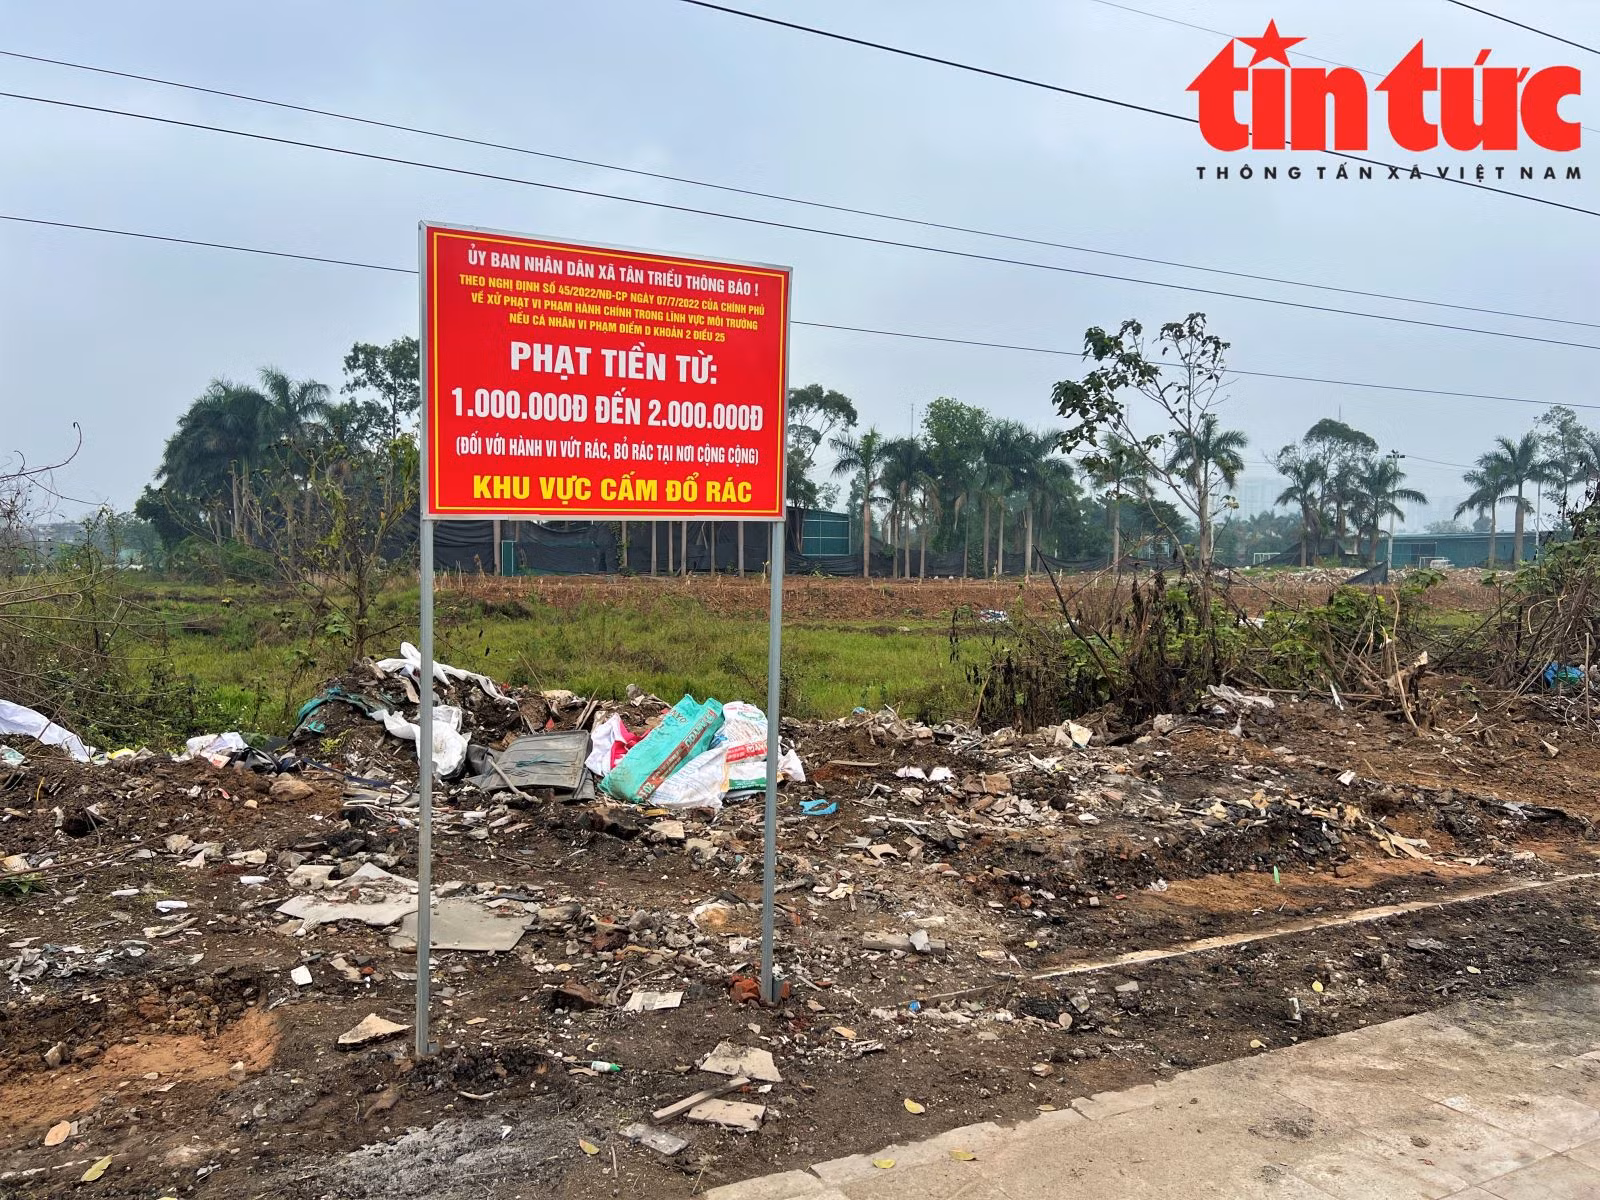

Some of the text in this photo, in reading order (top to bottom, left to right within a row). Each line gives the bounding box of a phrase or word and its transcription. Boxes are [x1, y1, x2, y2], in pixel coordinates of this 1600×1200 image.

[468, 243, 487, 266] ỦY
[491, 252, 520, 270] BAN
[524, 256, 562, 275] NHÂN
[566, 259, 595, 278] DÂN
[598, 263, 616, 281] XÃ
[619, 266, 644, 284] TÂN
[686, 274, 724, 293] THÔNG
[728, 278, 751, 296] BÁO
[754, 283, 759, 297] !
[459, 274, 486, 287] THEO
[488, 277, 513, 291] NGHỊ
[515, 280, 540, 293] ĐỊNH
[542, 281, 556, 294] SỐ
[630, 292, 655, 305] NGÀY
[656, 296, 699, 309] 07/7/2022
[701, 298, 719, 312] CỦA
[721, 301, 747, 314] CHÍNH
[748, 303, 765, 316] PHỦ
[503, 296, 530, 310] PHẠT
[532, 299, 542, 309] VI
[543, 300, 573, 314] PHẠM
[575, 303, 601, 315] HÀNH
[603, 306, 632, 318] CHÍNH
[634, 308, 664, 321] TRONG
[688, 314, 705, 327] VỰC
[707, 316, 724, 327] MÔI
[532, 314, 546, 326] CÁ
[548, 317, 576, 329] NHÂN
[578, 319, 587, 330] VI
[589, 321, 617, 334] PHẠM
[653, 325, 684, 339] KHOẢN
[685, 331, 692, 340] 2
[714, 332, 726, 342] 25
[511, 341, 717, 384] PHẠT TIỀN TỪ:
[451, 387, 764, 431] 1.000.000Đ ĐẾN 2.000.000Đ
[456, 430, 759, 467] (ĐỐI VỚI HÀNH VI VỨT RÁC, BỎ RÁC TẠI NƠI CỘNG CỘNG)
[473, 470, 752, 505] KHU VỰC CẤM ĐỔ RÁC
